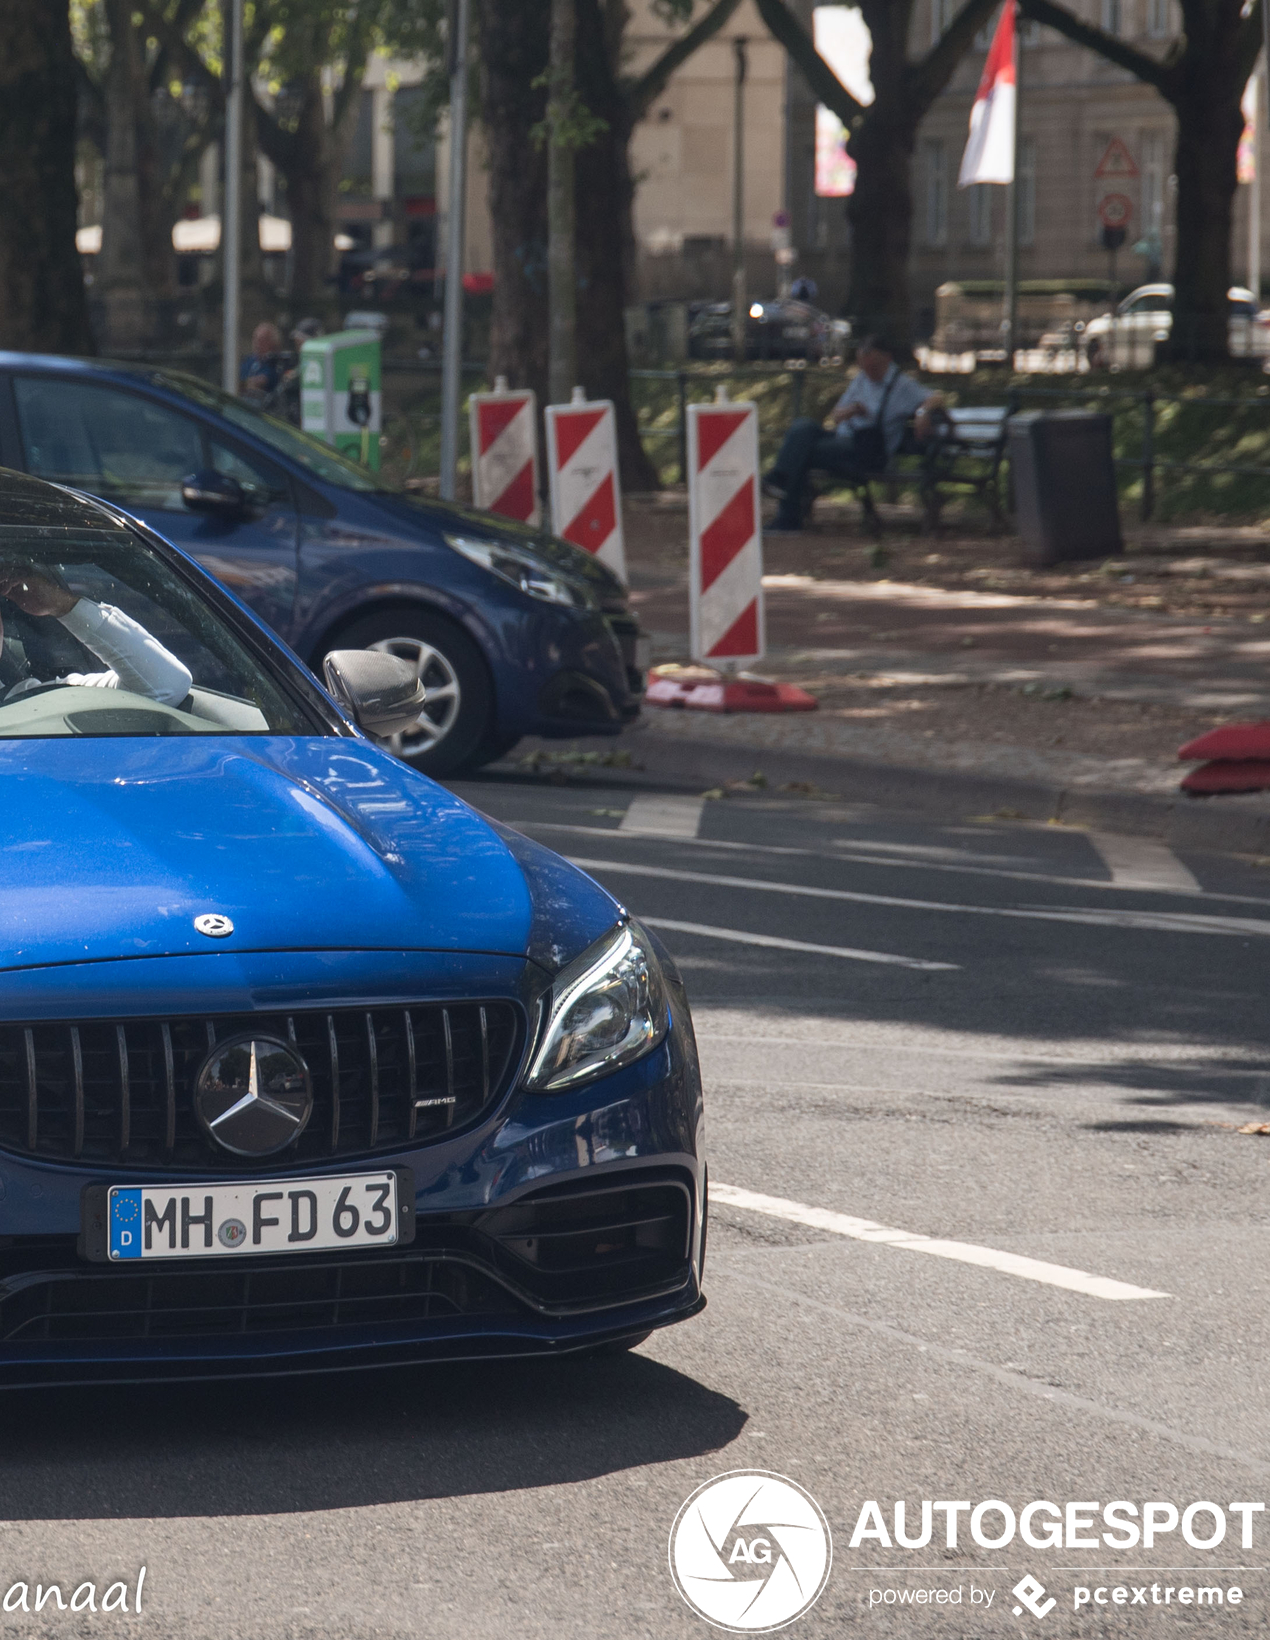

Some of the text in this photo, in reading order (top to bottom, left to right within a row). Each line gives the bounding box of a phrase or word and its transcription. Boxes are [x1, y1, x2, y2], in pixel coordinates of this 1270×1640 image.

[427, 1096, 456, 1106] AMG
[144, 1183, 392, 1249] MH FD 63
[121, 1231, 132, 1246] D
